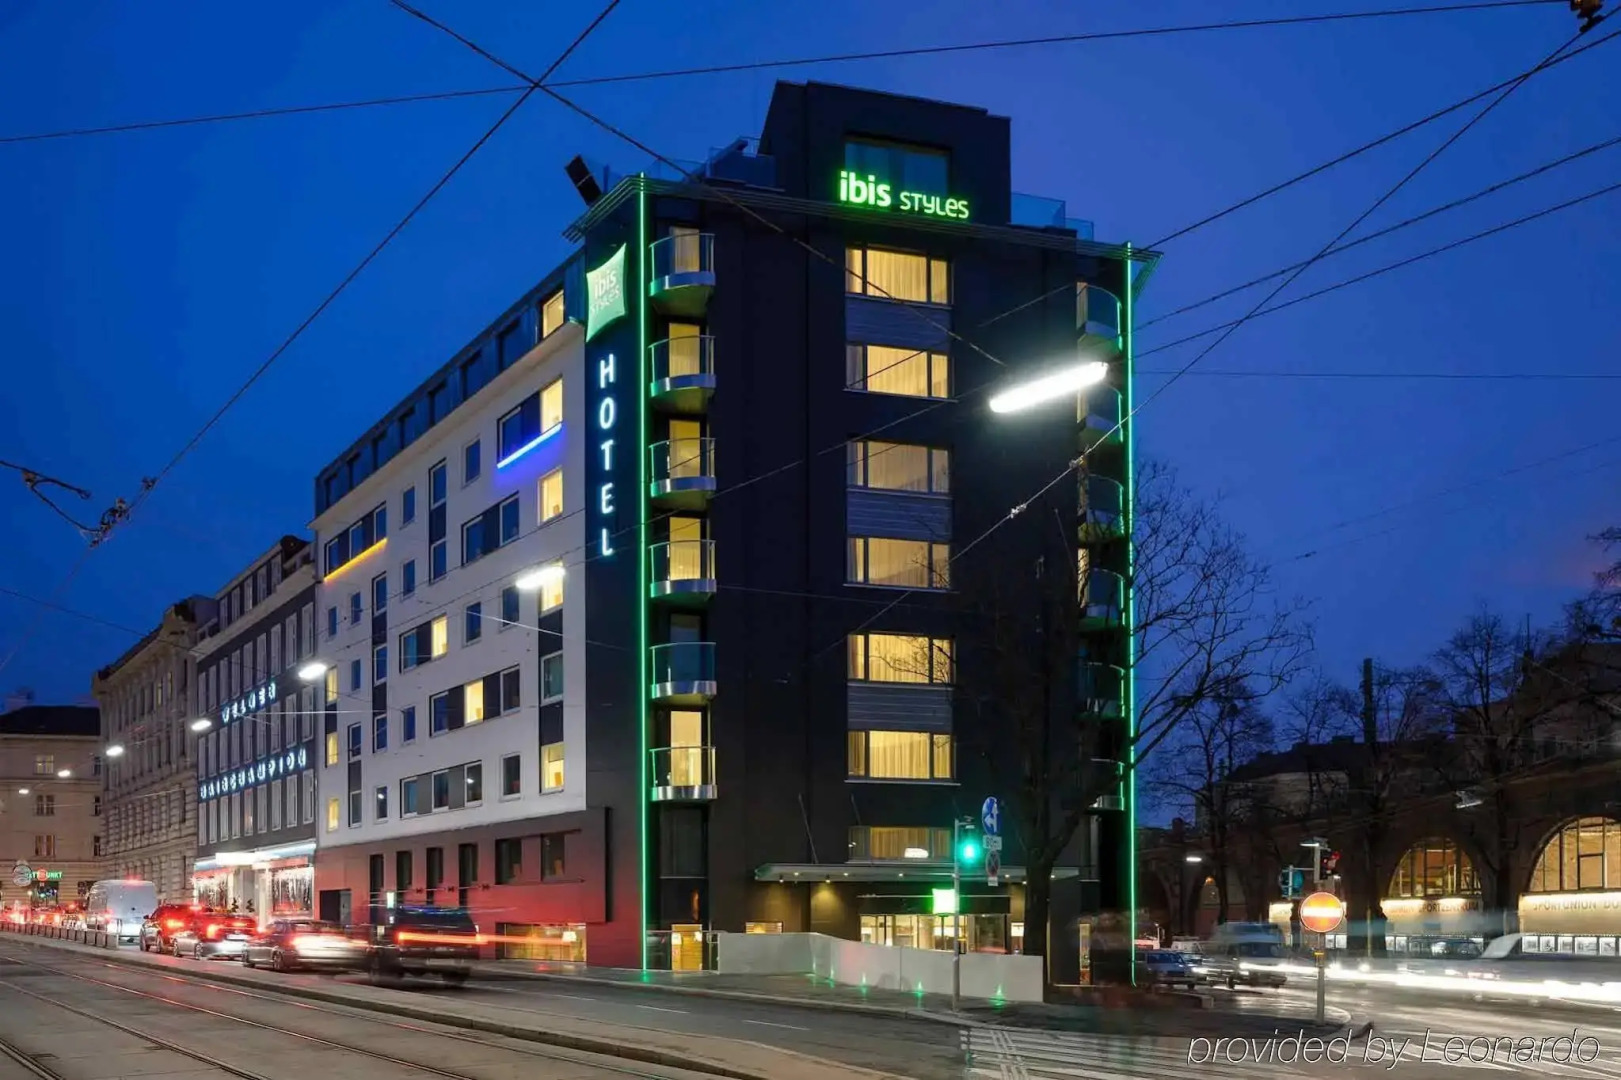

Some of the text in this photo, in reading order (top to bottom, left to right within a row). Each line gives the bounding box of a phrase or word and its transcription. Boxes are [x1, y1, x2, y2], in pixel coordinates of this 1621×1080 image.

[840, 171, 891, 207] ibis
[594, 269, 617, 300] ibis
[600, 353, 615, 557] HOTEL
